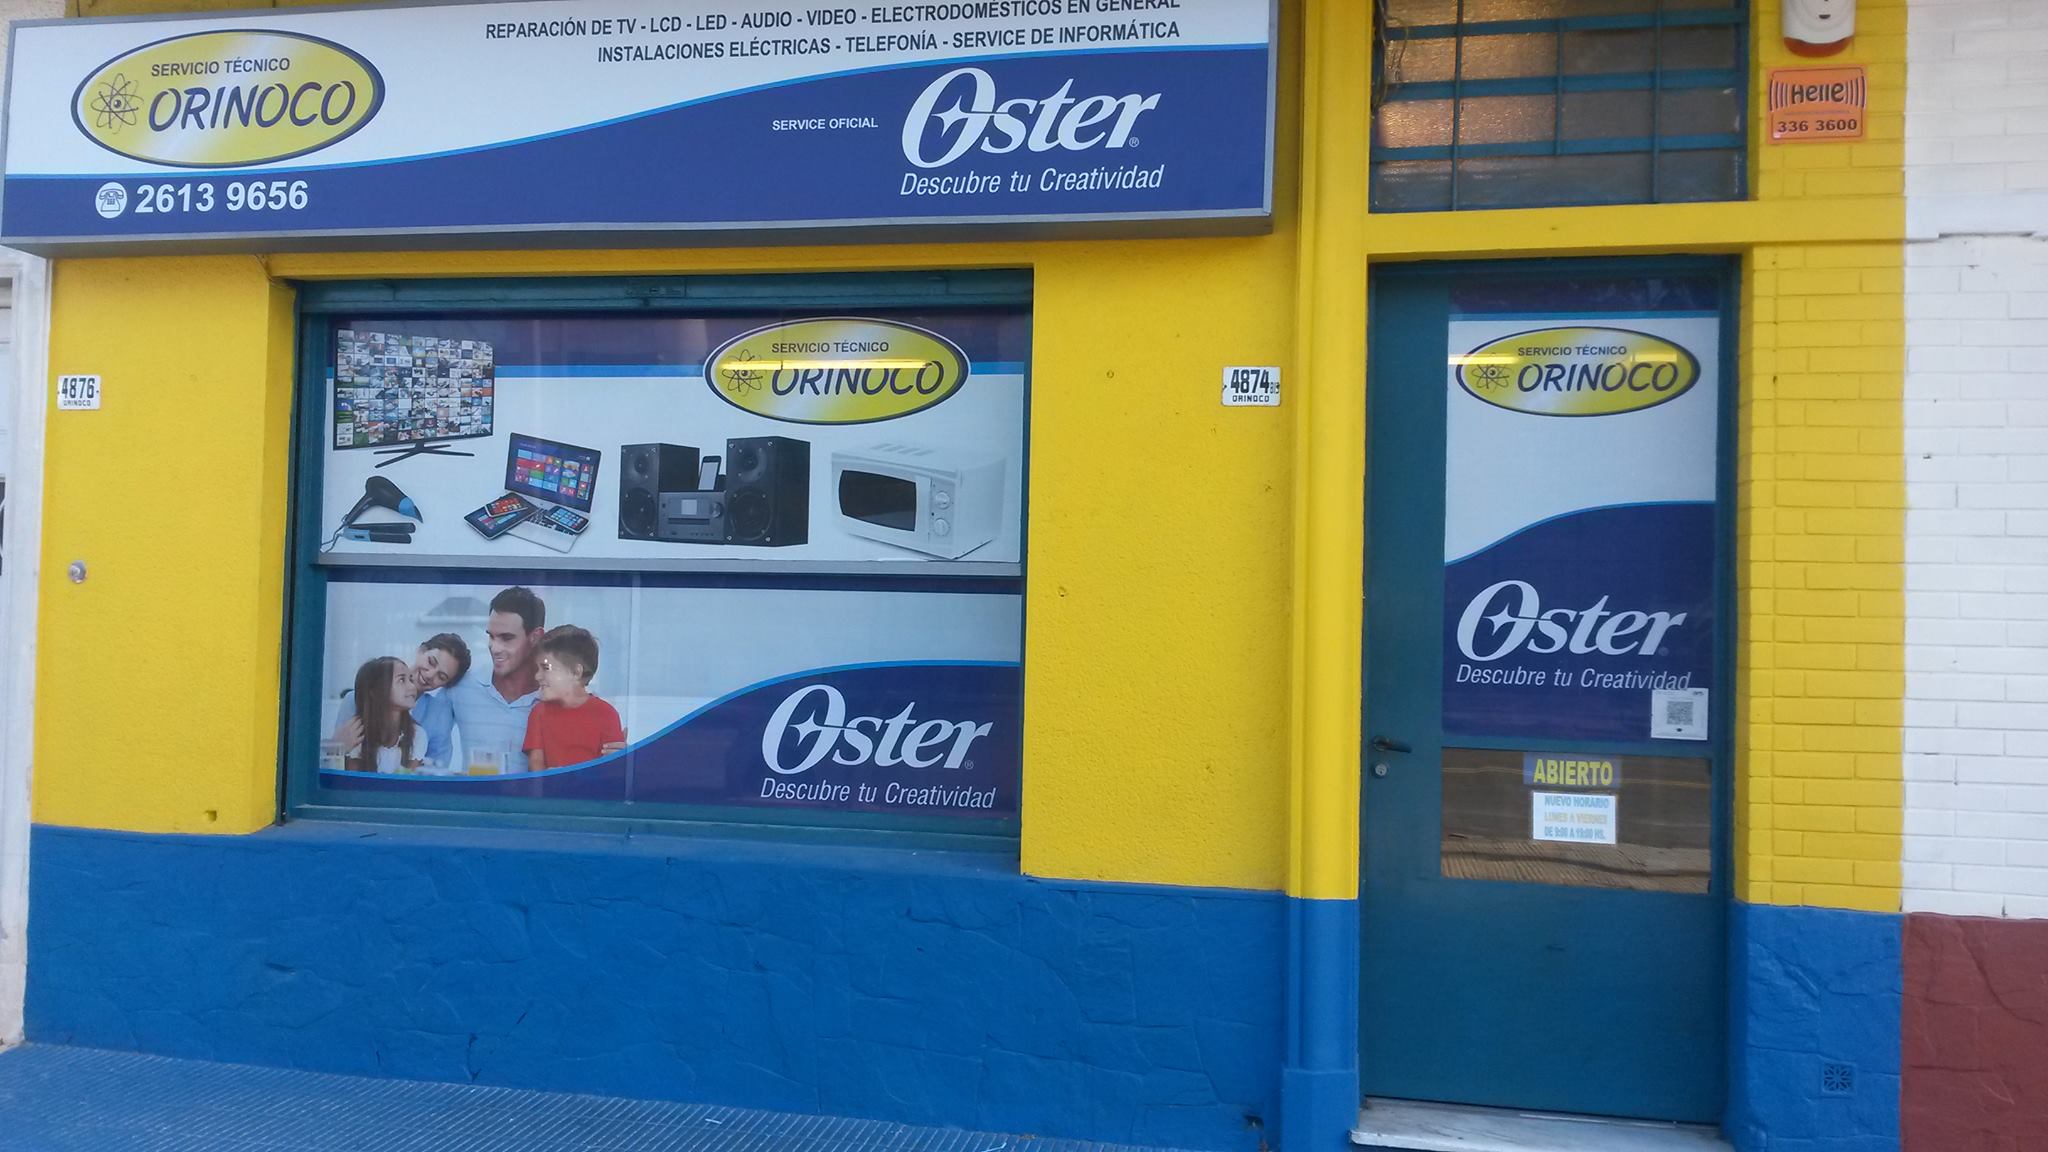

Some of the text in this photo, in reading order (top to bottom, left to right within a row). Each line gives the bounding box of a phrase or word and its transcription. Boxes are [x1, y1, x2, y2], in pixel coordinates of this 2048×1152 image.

[486, 17, 586, 39] REPARACIÓN
[591, 20, 612, 36] DE
[616, 18, 637, 34] TV
[650, 16, 682, 33] LCD
[696, 14, 727, 31] LED
[741, 11, 792, 29] AUDIO
[806, 8, 857, 26] VIDEO
[871, 0, 1062, 24] ELECTRODOMÉSTICOS
[1067, 0, 1090, 14] EN
[1096, 0, 1181, 12] GENERAL
[598, 42, 724, 62] INSTALACIONES
[729, 37, 831, 57] ELÉCTRICAS
[845, 30, 938, 52] TELEFONÍA
[952, 29, 1025, 48] SERVICE
[1030, 28, 1054, 45] DE
[1059, 19, 1180, 43] INFORMÁTICA
[151, 56, 290, 77] SERVICIO TÉCNICO
[148, 80, 356, 132] ORINOCO
[902, 67, 1162, 169] Oster
[772, 117, 878, 131] SERVICE OFICIAL
[1778, 119, 1857, 132] 336 3600
[900, 164, 1165, 197] Descubre tu Creatividad
[135, 180, 309, 214] 2613 9656
[771, 339, 889, 353] SERVICIO TÉCNICO
[1517, 344, 1627, 356] SERVICIO TÉCNICO
[61, 377, 96, 399] 4876
[771, 360, 944, 396] ORINOCO
[1230, 369, 1270, 393] 4874
[1517, 362, 1679, 392] ORINOCO
[1457, 580, 1688, 661] Oster
[1456, 664, 1692, 690] Descubre tu Creatividad
[762, 684, 993, 775] Oster
[1533, 758, 1613, 785] ABIERTO
[760, 777, 997, 808] Descubre tu Creatividad
[1544, 796, 1610, 808] NUEVO HORARIO
